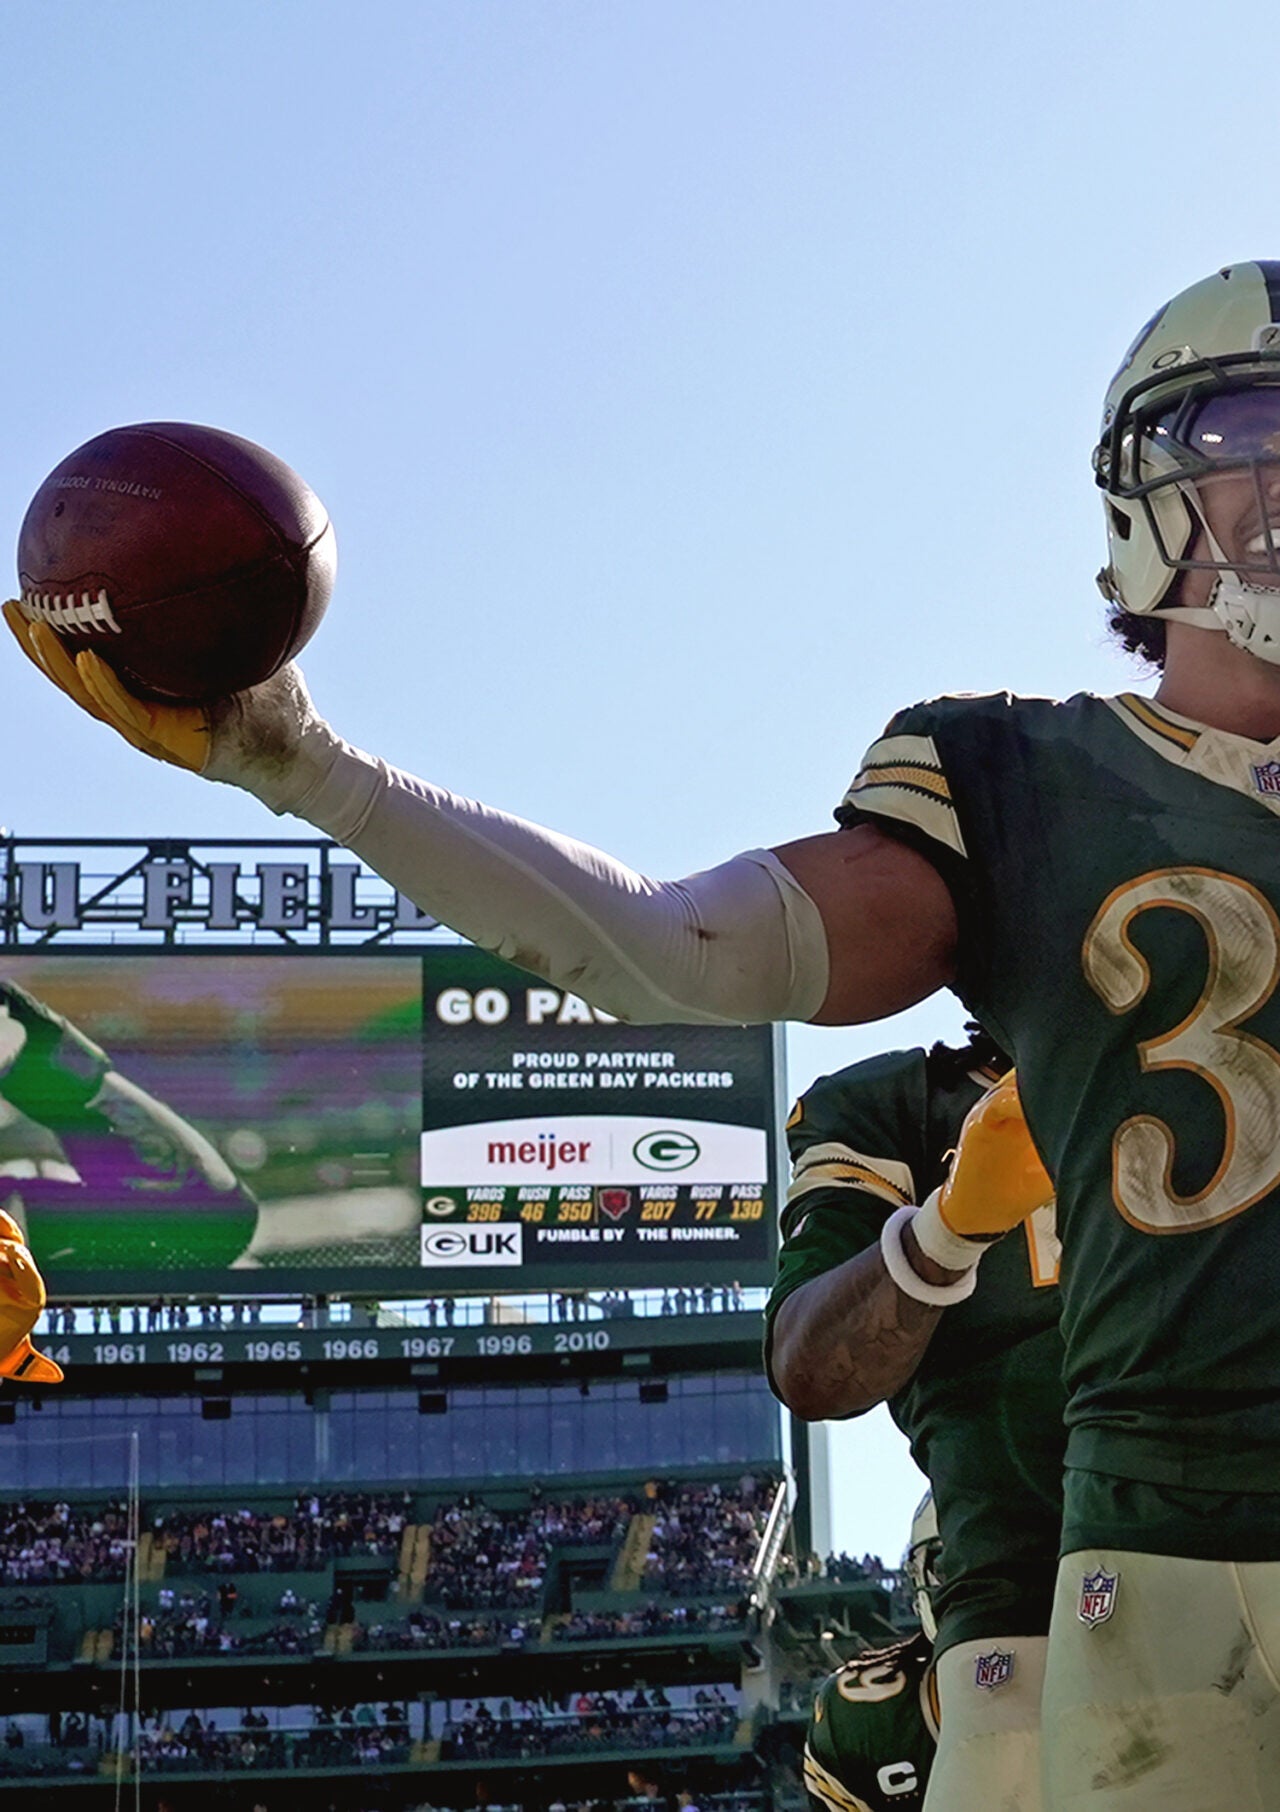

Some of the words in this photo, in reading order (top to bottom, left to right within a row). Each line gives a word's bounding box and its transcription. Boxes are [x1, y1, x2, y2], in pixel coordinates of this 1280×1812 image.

[94, 478, 162, 500] NATIONAL
[436, 987, 509, 1024] GO
[526, 987, 619, 1024] PA
[512, 1053, 580, 1068] PROUD
[585, 1053, 675, 1068] PARTNER
[453, 1073, 478, 1088] OF
[486, 1073, 523, 1088] THE
[528, 1073, 594, 1088] GREEN
[600, 1072, 637, 1088] BAY
[644, 1072, 734, 1088] PACKERS
[487, 1133, 591, 1170] meijer
[466, 1187, 506, 1201] YARDS
[517, 1187, 551, 1200] RUSH
[558, 1187, 592, 1200] PASS
[639, 1186, 678, 1200] YARDS
[690, 1185, 723, 1199] RUSH
[730, 1185, 763, 1199] PASS
[557, 1203, 592, 1221] 350
[640, 1202, 676, 1221] 207
[695, 1202, 717, 1220] 77
[730, 1202, 763, 1220] 130
[537, 1228, 600, 1242] FUMBLE
[603, 1228, 626, 1242] BY
[636, 1228, 669, 1242] THE
[670, 1228, 740, 1241] RUNNER.
[93, 1343, 146, 1364] 1961
[167, 1342, 224, 1363] 1962
[245, 1341, 301, 1362] 1965
[322, 1339, 379, 1360] 1966
[401, 1337, 455, 1358] 1967
[476, 1334, 532, 1355] 1996
[553, 1331, 610, 1352] 2010
[1083, 1592, 1109, 1615] NFL
[979, 1664, 1007, 1683] NFL
[876, 1760, 918, 1796] C
